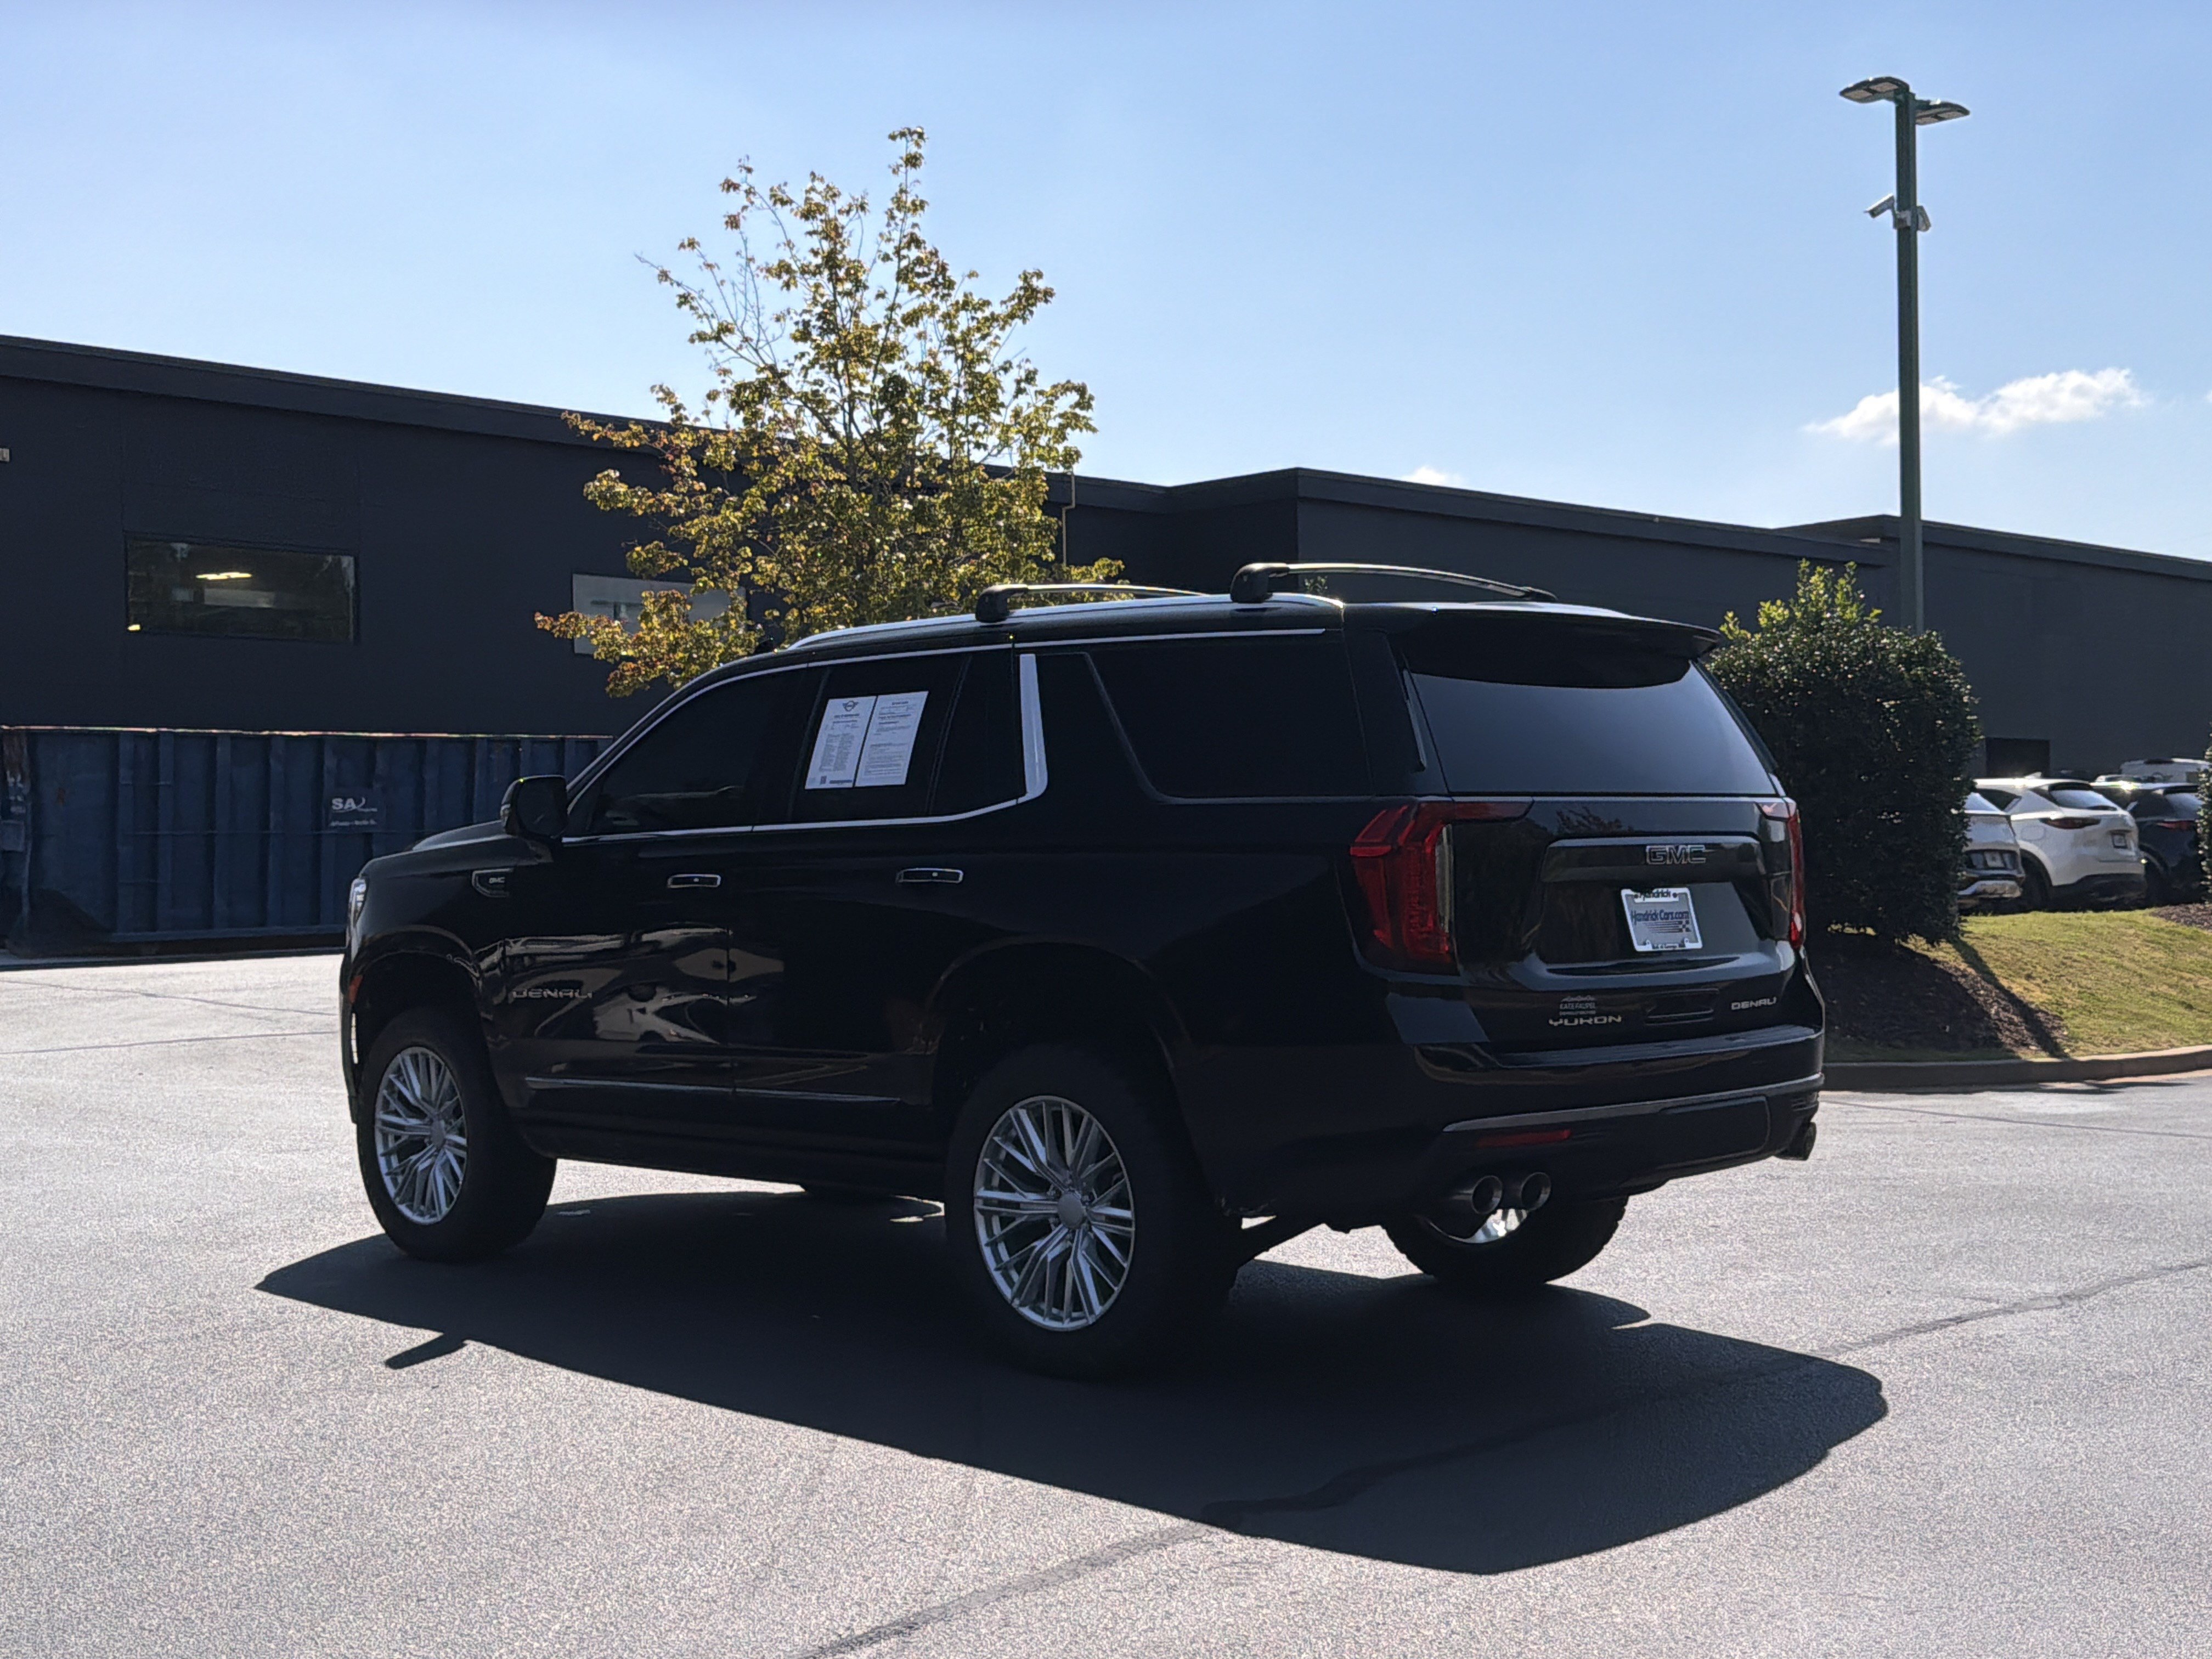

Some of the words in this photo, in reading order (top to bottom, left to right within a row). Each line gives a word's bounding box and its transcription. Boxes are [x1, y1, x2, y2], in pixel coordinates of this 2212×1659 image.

[1646, 844, 1706, 865] GMC
[513, 989, 592, 998] DENALI
[1731, 996, 1777, 1010] DENALI
[1548, 1014, 1622, 1027] YUKON
